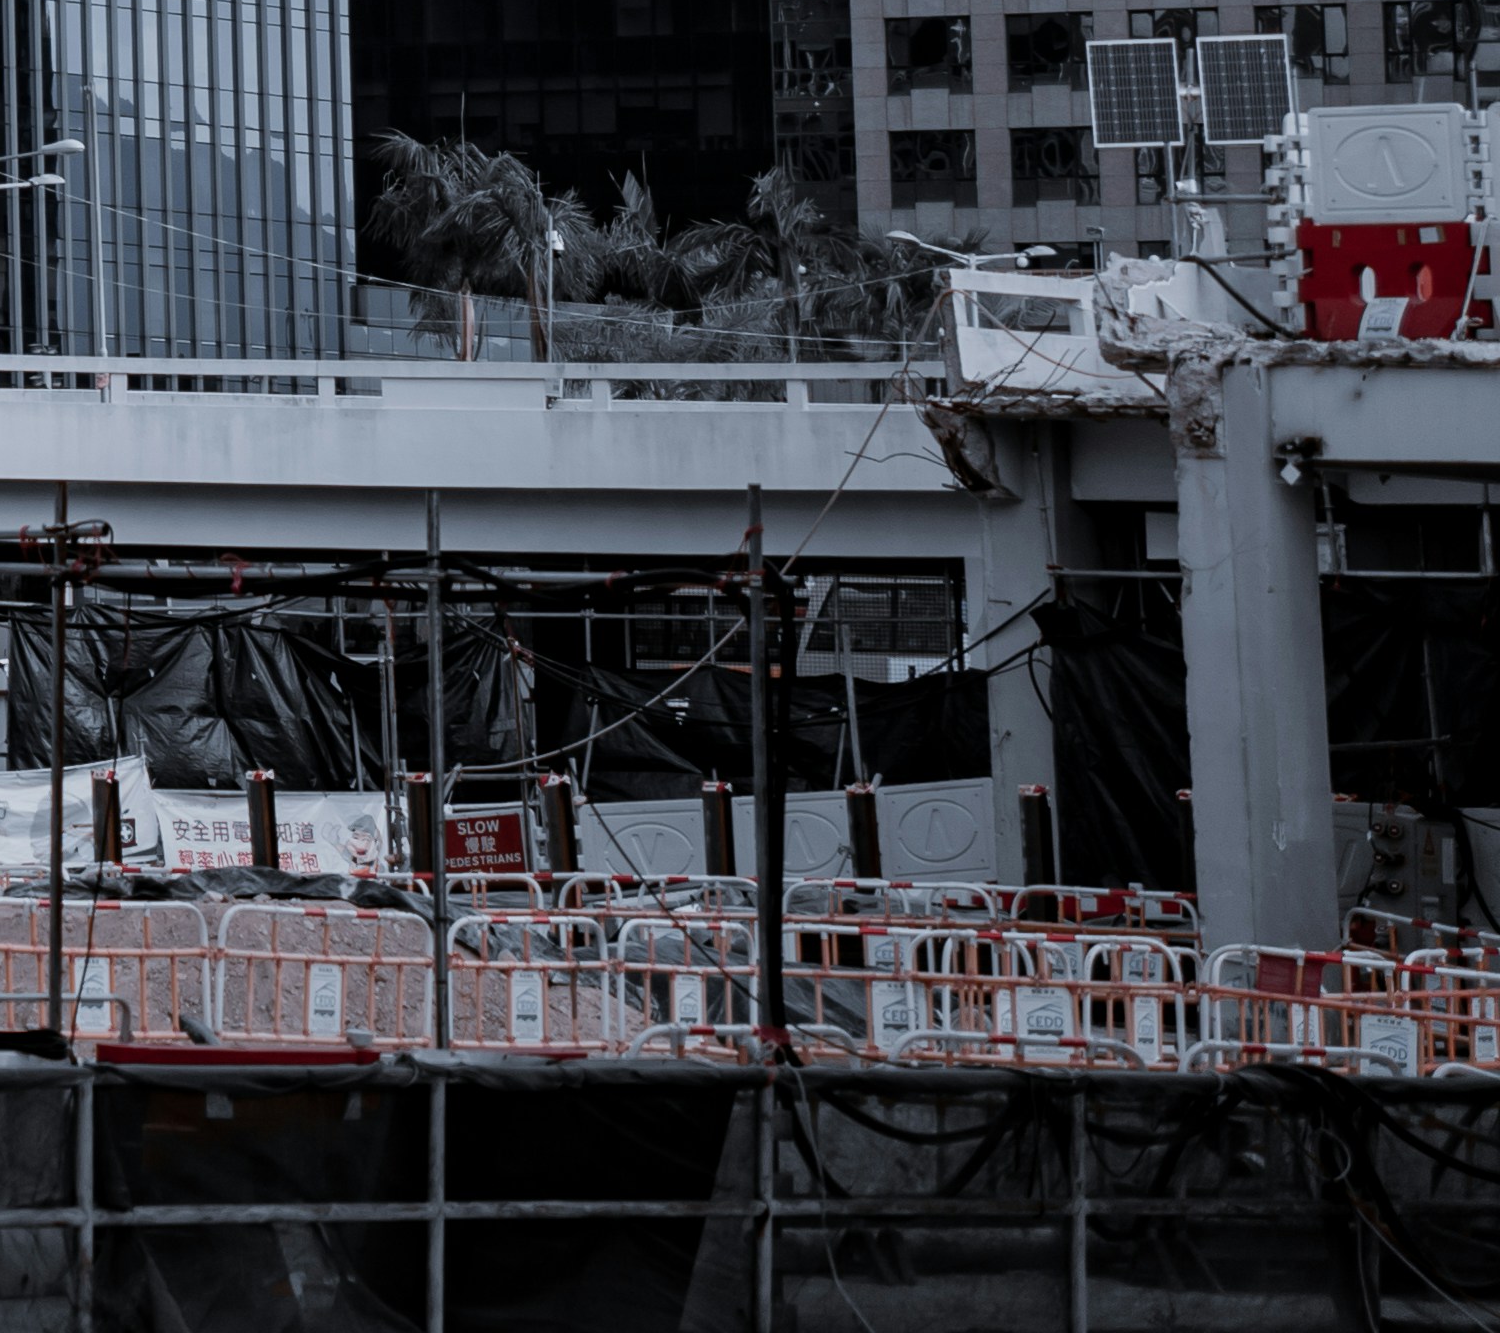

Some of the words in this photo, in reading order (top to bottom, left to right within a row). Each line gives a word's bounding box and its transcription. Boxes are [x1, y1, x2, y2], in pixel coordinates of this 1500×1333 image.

[172, 819, 315, 844] 安全用電知道
[457, 819, 499, 836] SLOW
[1026, 1015, 1064, 1029] CEDD
